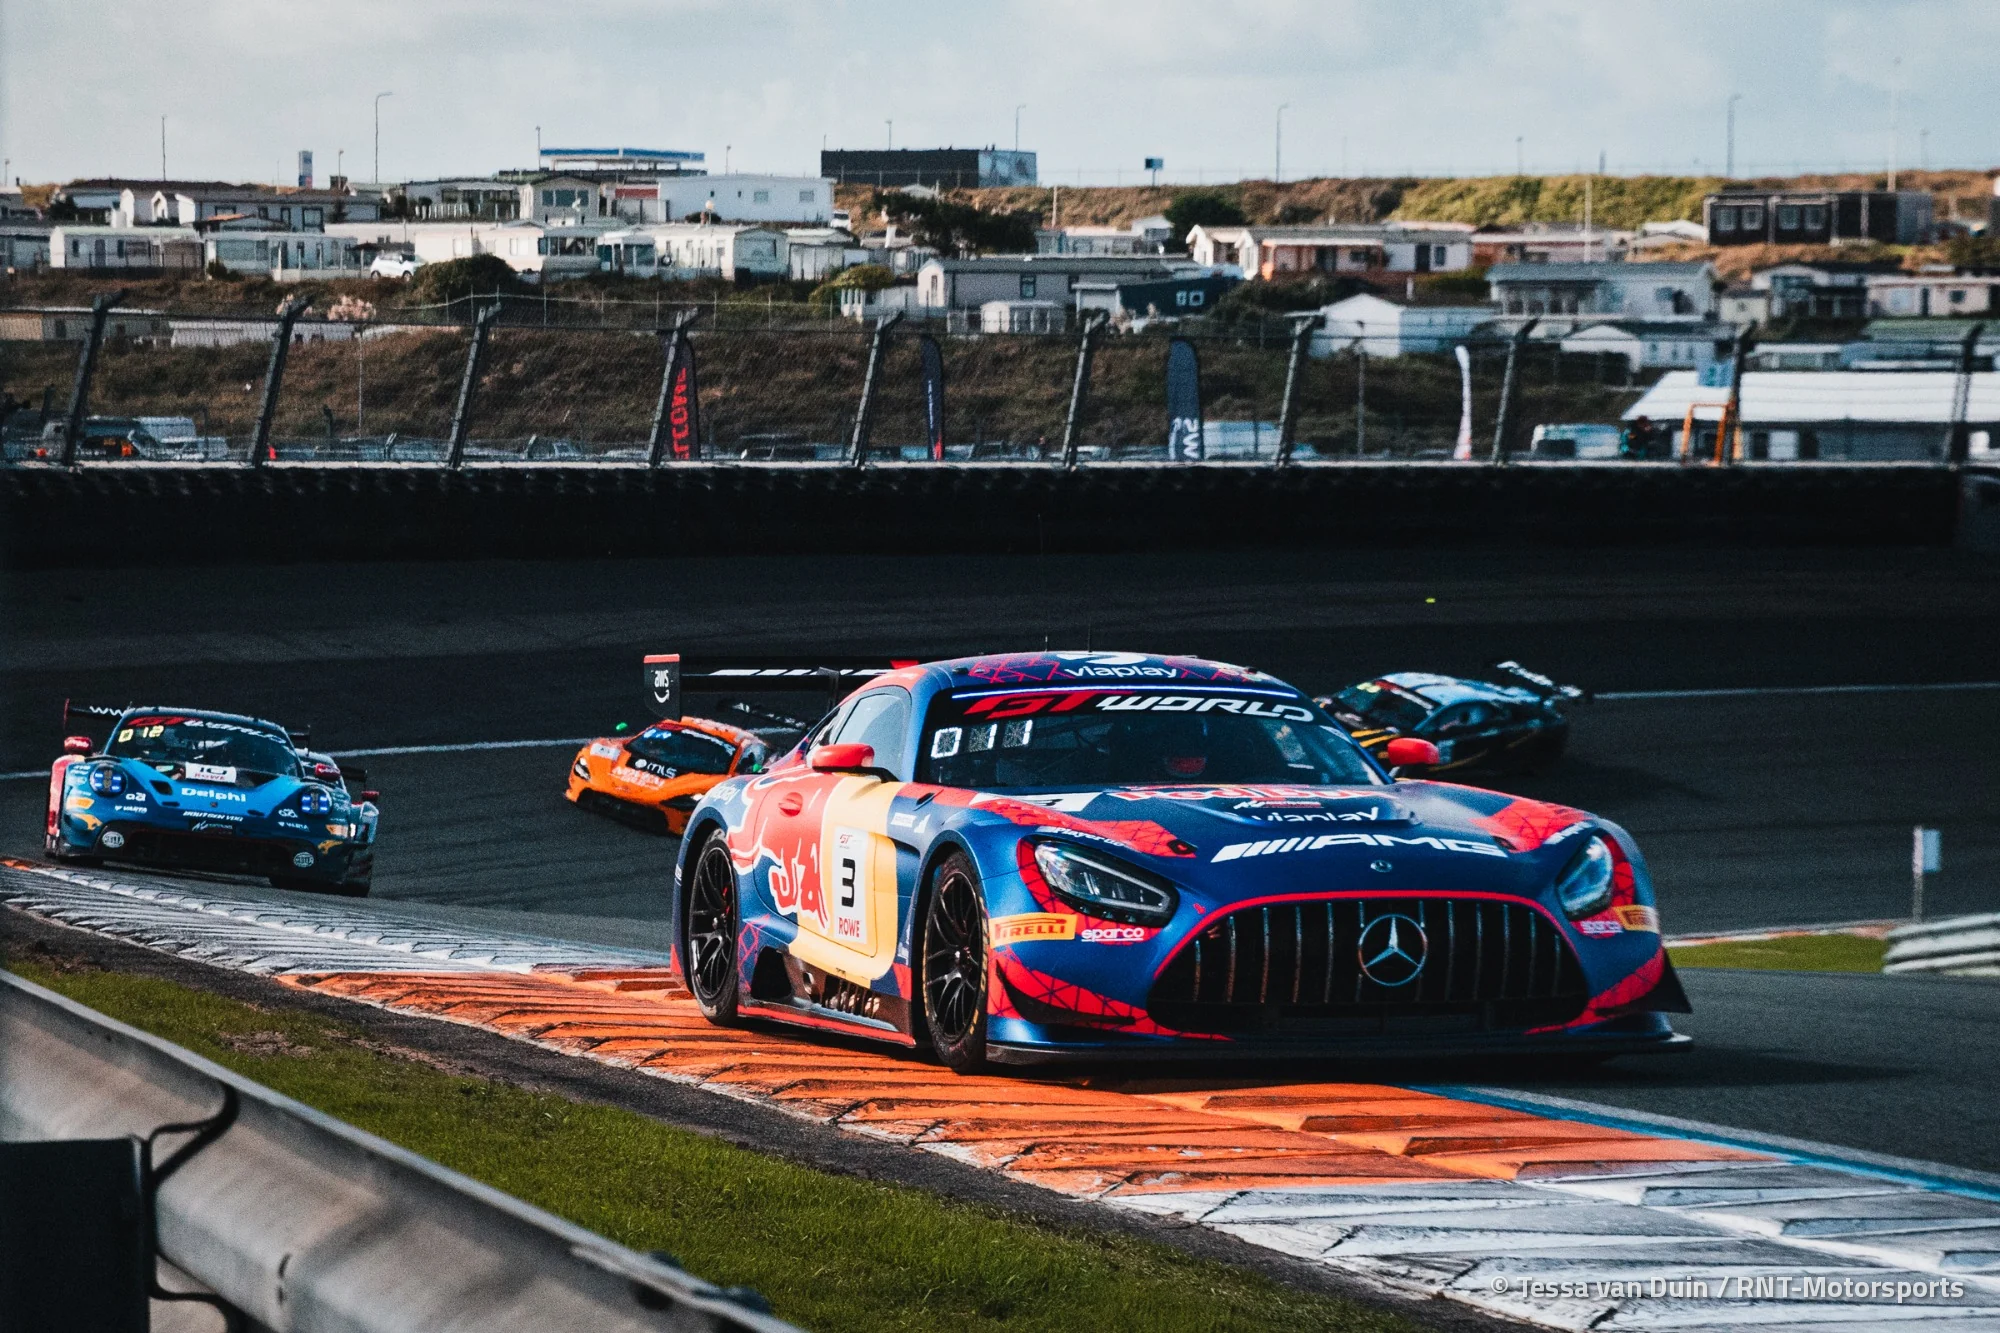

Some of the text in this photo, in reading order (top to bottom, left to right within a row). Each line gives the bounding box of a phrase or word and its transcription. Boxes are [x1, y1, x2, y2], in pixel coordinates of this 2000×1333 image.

[654, 669, 670, 688] aws
[1065, 664, 1177, 679] viaplay
[964, 690, 1315, 722] GT WORLD
[181, 787, 247, 803] Delphi
[841, 858, 856, 908] 3
[838, 917, 861, 938] ROWE
[994, 918, 1066, 940] PIRELLI
[1081, 927, 1145, 942] sparco
